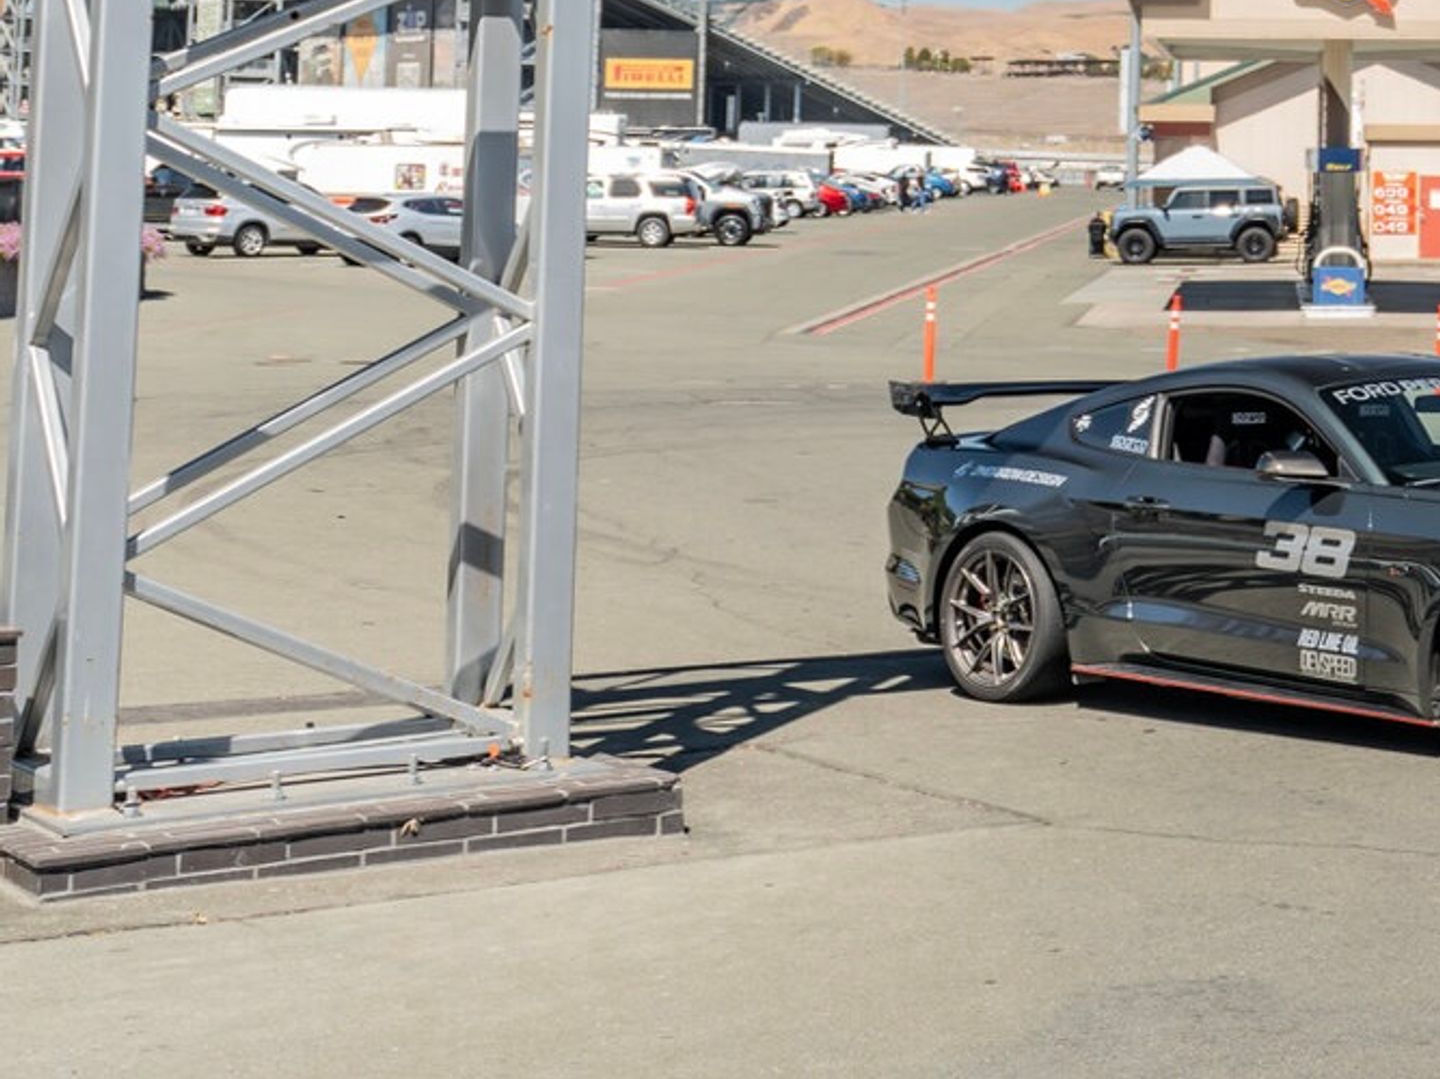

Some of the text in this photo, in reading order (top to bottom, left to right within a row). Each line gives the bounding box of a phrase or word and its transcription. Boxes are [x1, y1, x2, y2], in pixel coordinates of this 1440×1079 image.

[1332, 380, 1402, 405] FORD
[1255, 521, 1356, 579] 38
[1298, 583, 1357, 600] STEEDA
[1300, 601, 1357, 622] MRR
[1297, 628, 1320, 648] RED
[1318, 631, 1343, 651] LINE
